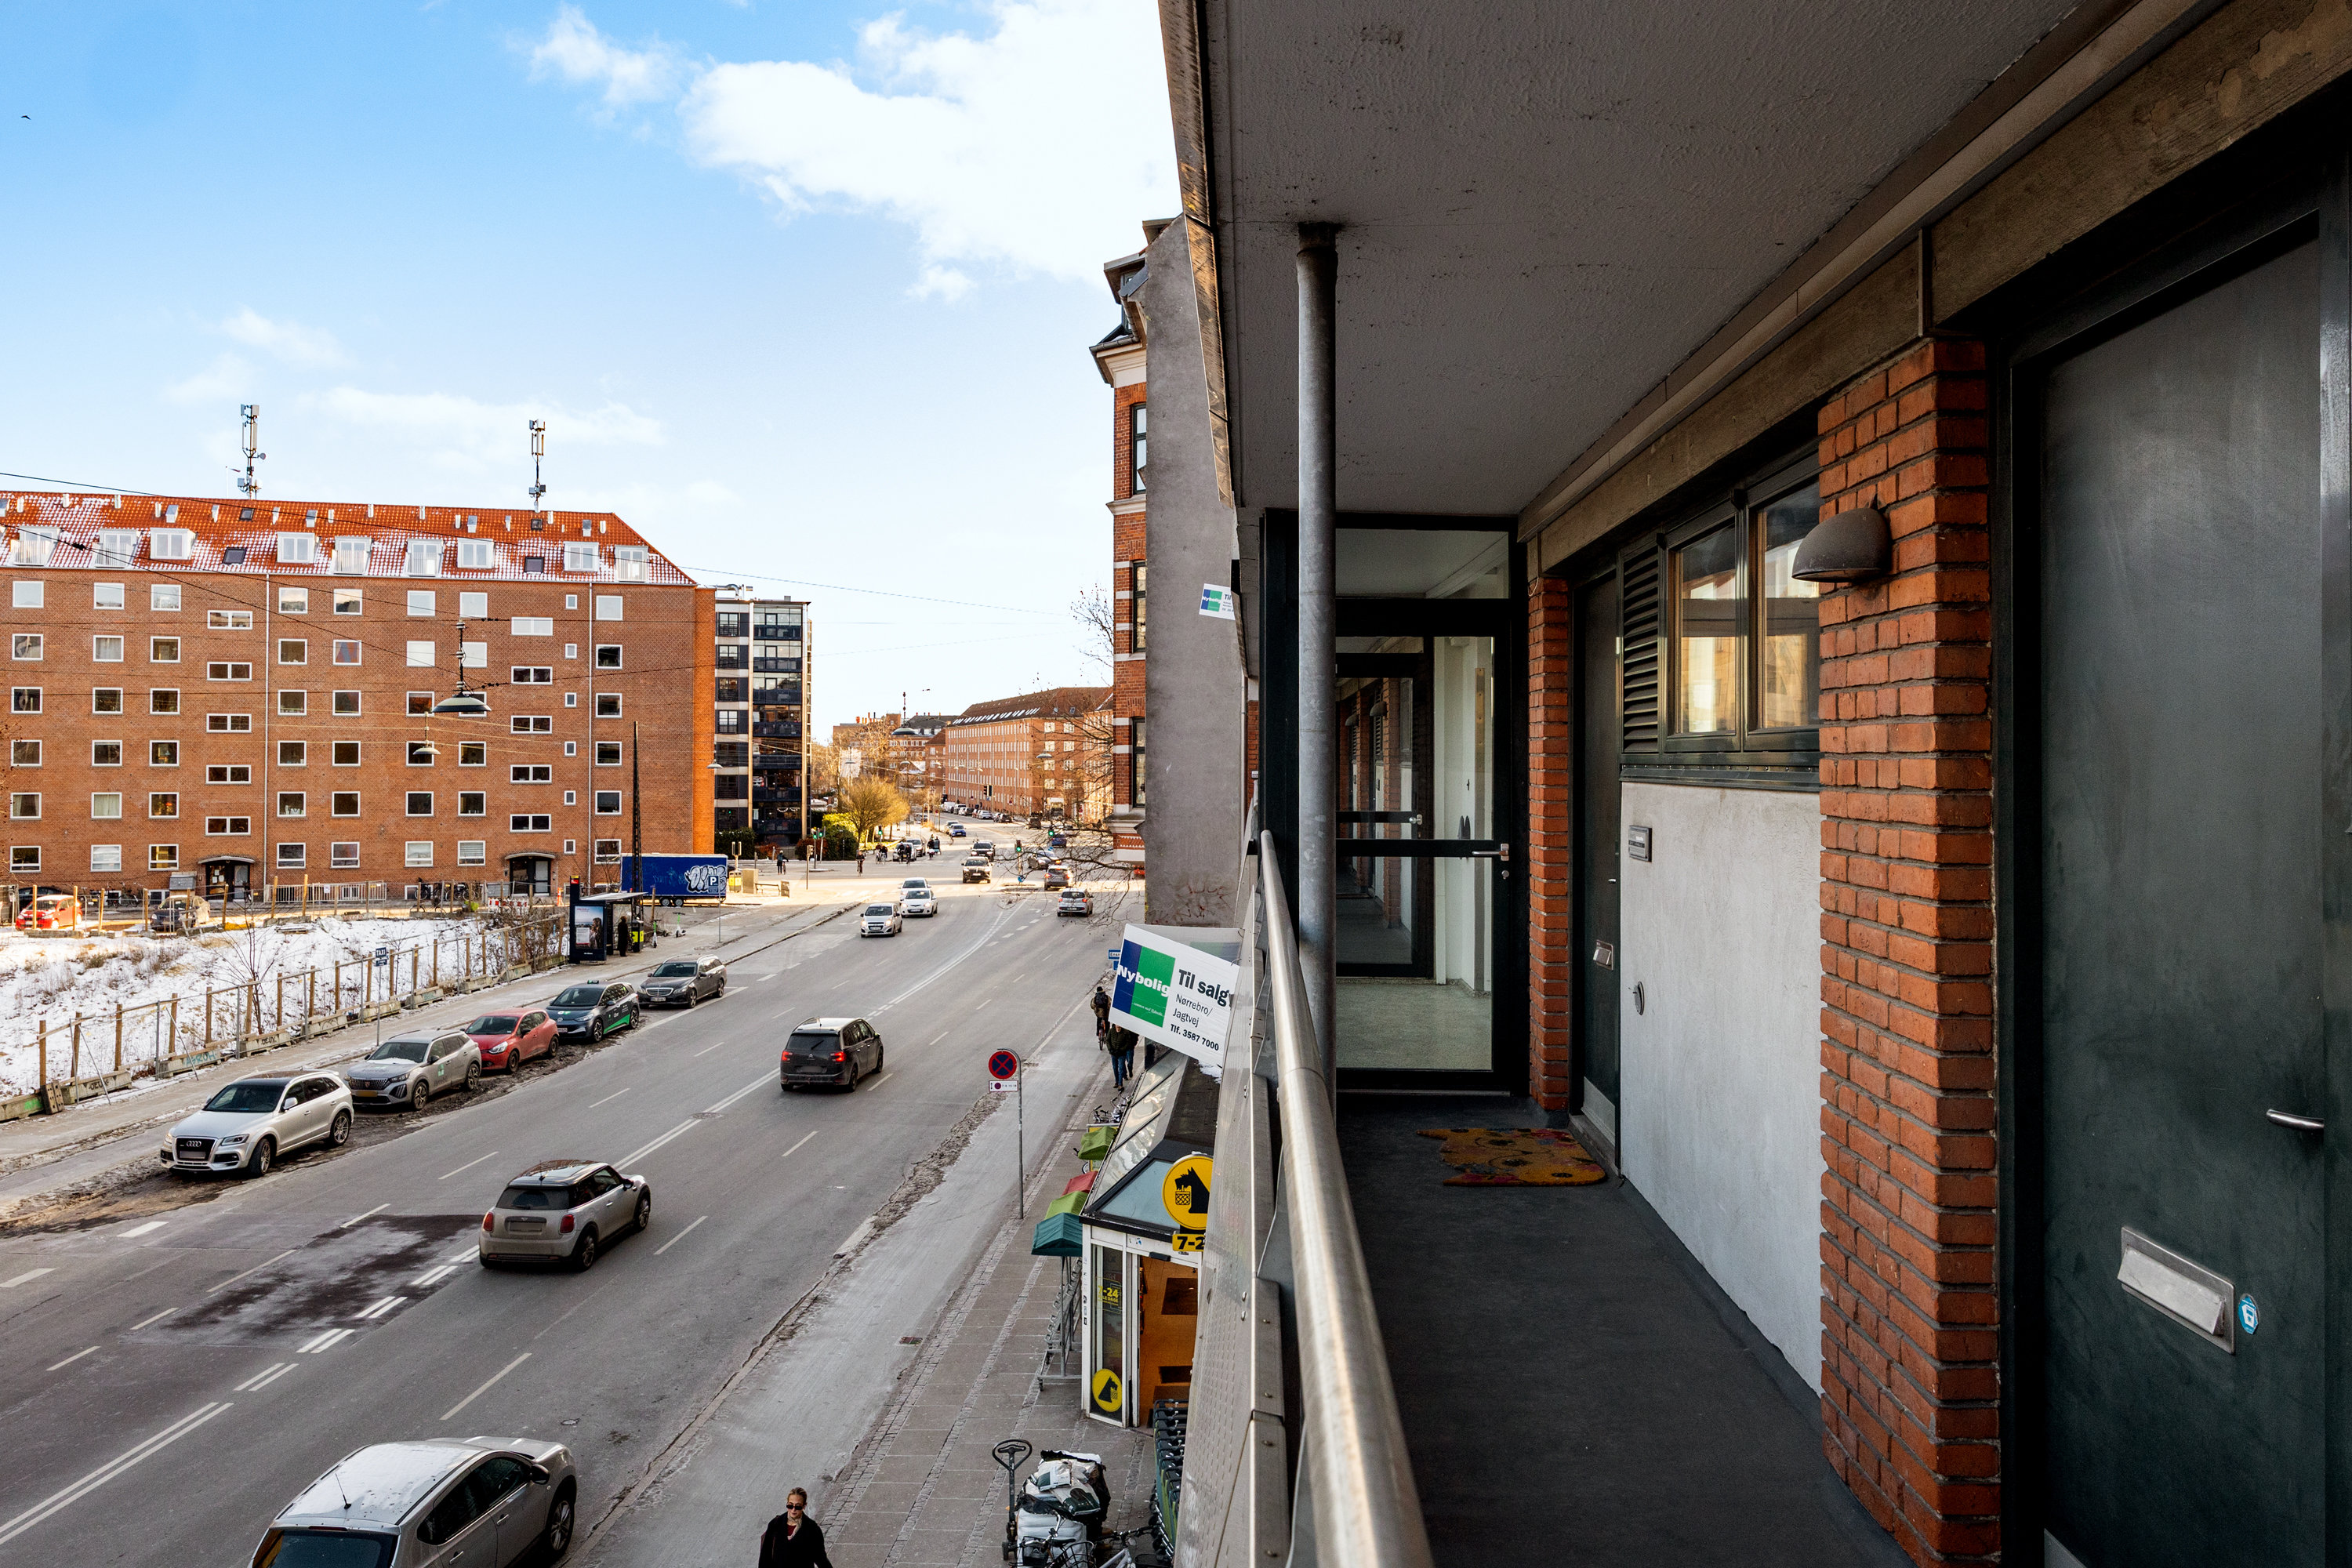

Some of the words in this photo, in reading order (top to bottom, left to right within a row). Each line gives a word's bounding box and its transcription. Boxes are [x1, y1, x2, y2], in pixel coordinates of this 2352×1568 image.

[710, 877, 717, 886] P
[1117, 964, 1171, 997] Nybolig
[1178, 969, 1196, 989] Til
[1197, 981, 1230, 1007] salg
[1176, 993, 1213, 1017] Nørrebro/
[1173, 1008, 1199, 1028] Jagtvej
[1182, 1029, 1200, 1042] 3587
[1202, 1037, 1219, 1051] 7000
[1098, 1285, 1118, 1298] 7-24
